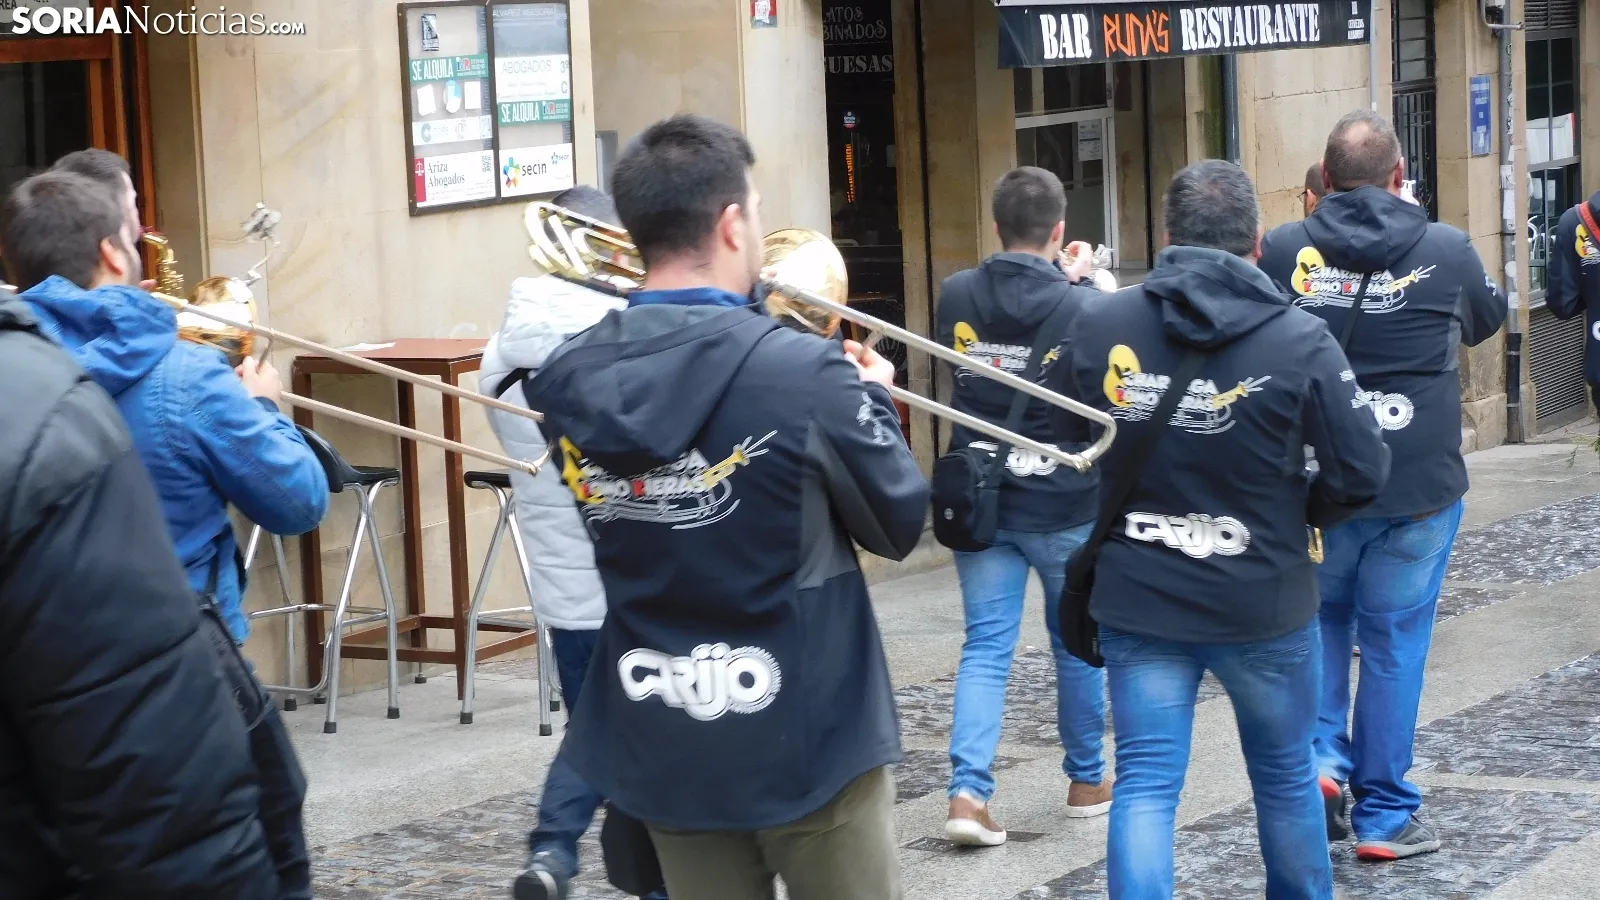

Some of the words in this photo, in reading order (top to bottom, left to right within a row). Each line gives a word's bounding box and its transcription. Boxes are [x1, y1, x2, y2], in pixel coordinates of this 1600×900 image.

[823, 6, 864, 23] ATOS
[1040, 13, 1092, 59] BAR
[1180, 3, 1320, 50] RESTAURANTE
[412, 60, 423, 80] SE
[423, 58, 454, 80] ALQUILA
[502, 59, 552, 75] ABOGADOS
[502, 103, 511, 123] SE
[512, 102, 540, 123] ALQUILA
[428, 160, 448, 174] Ariza
[521, 160, 547, 177] secin
[428, 172, 466, 189] Abogados
